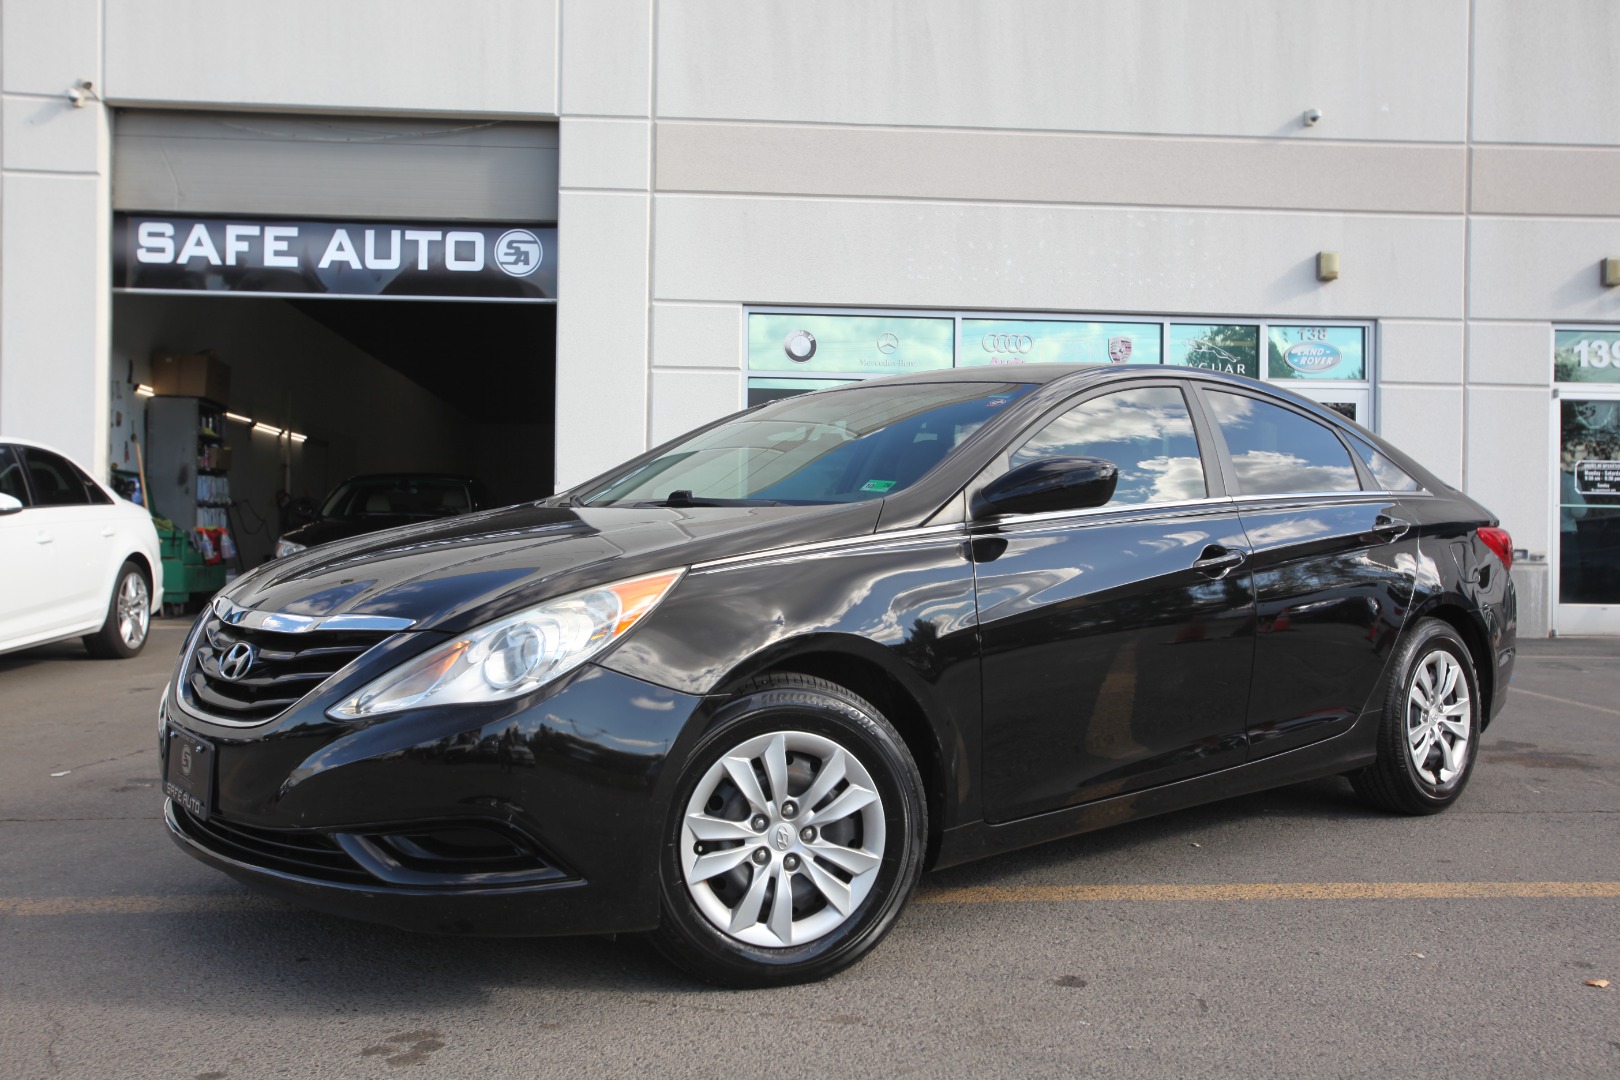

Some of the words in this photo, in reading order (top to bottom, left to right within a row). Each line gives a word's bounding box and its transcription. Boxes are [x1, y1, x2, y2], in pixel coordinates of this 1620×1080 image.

[137, 222, 299, 268] SAFE
[317, 228, 485, 272] AUTO
[859, 359, 918, 367] Mercedes-Benz
[1300, 356, 1334, 365] ROVER
[1573, 339, 1620, 369] 139
[183, 793, 200, 814] AUTO
